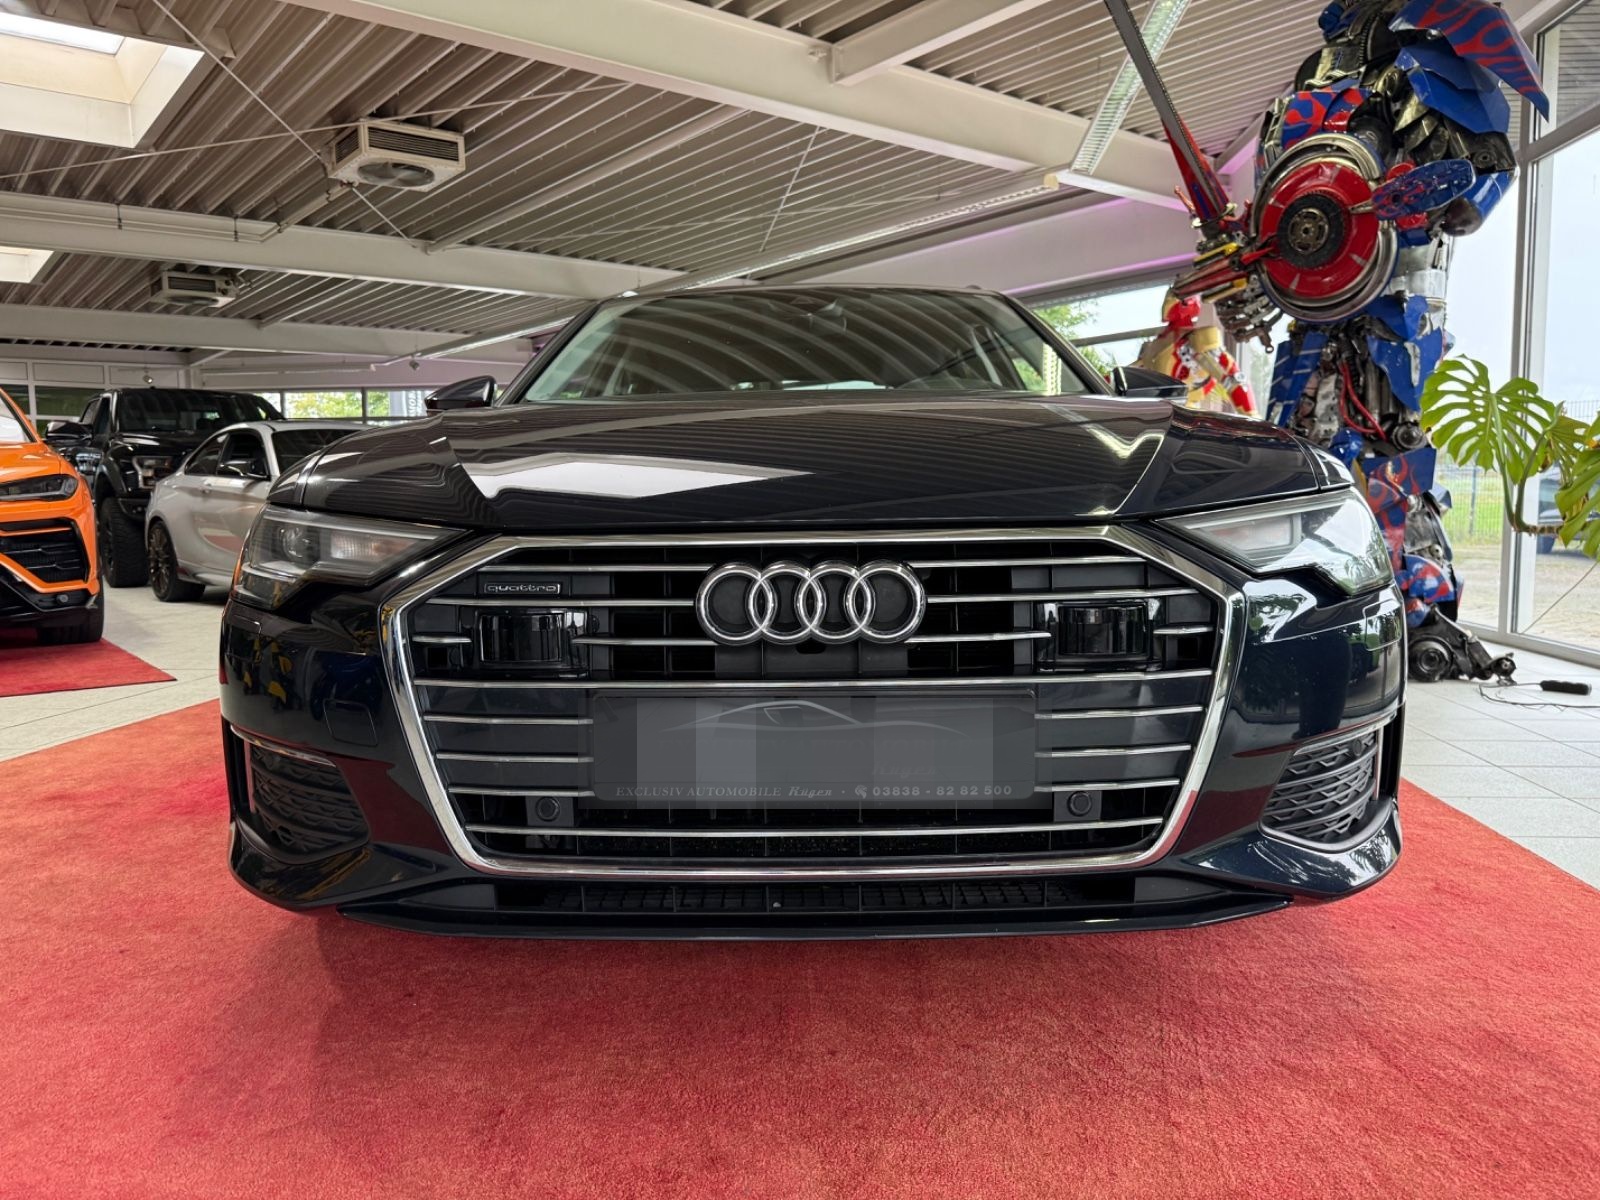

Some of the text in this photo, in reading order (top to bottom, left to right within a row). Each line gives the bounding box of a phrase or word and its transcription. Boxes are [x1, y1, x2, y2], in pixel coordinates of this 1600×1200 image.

[487, 584, 557, 593] quattro
[616, 786, 685, 797] EXCLUSIV
[687, 786, 782, 797] AUTOMOBILE
[872, 785, 921, 797] 03838
[936, 785, 955, 796] 82
[959, 785, 979, 796] 82
[984, 785, 1012, 796] 500
